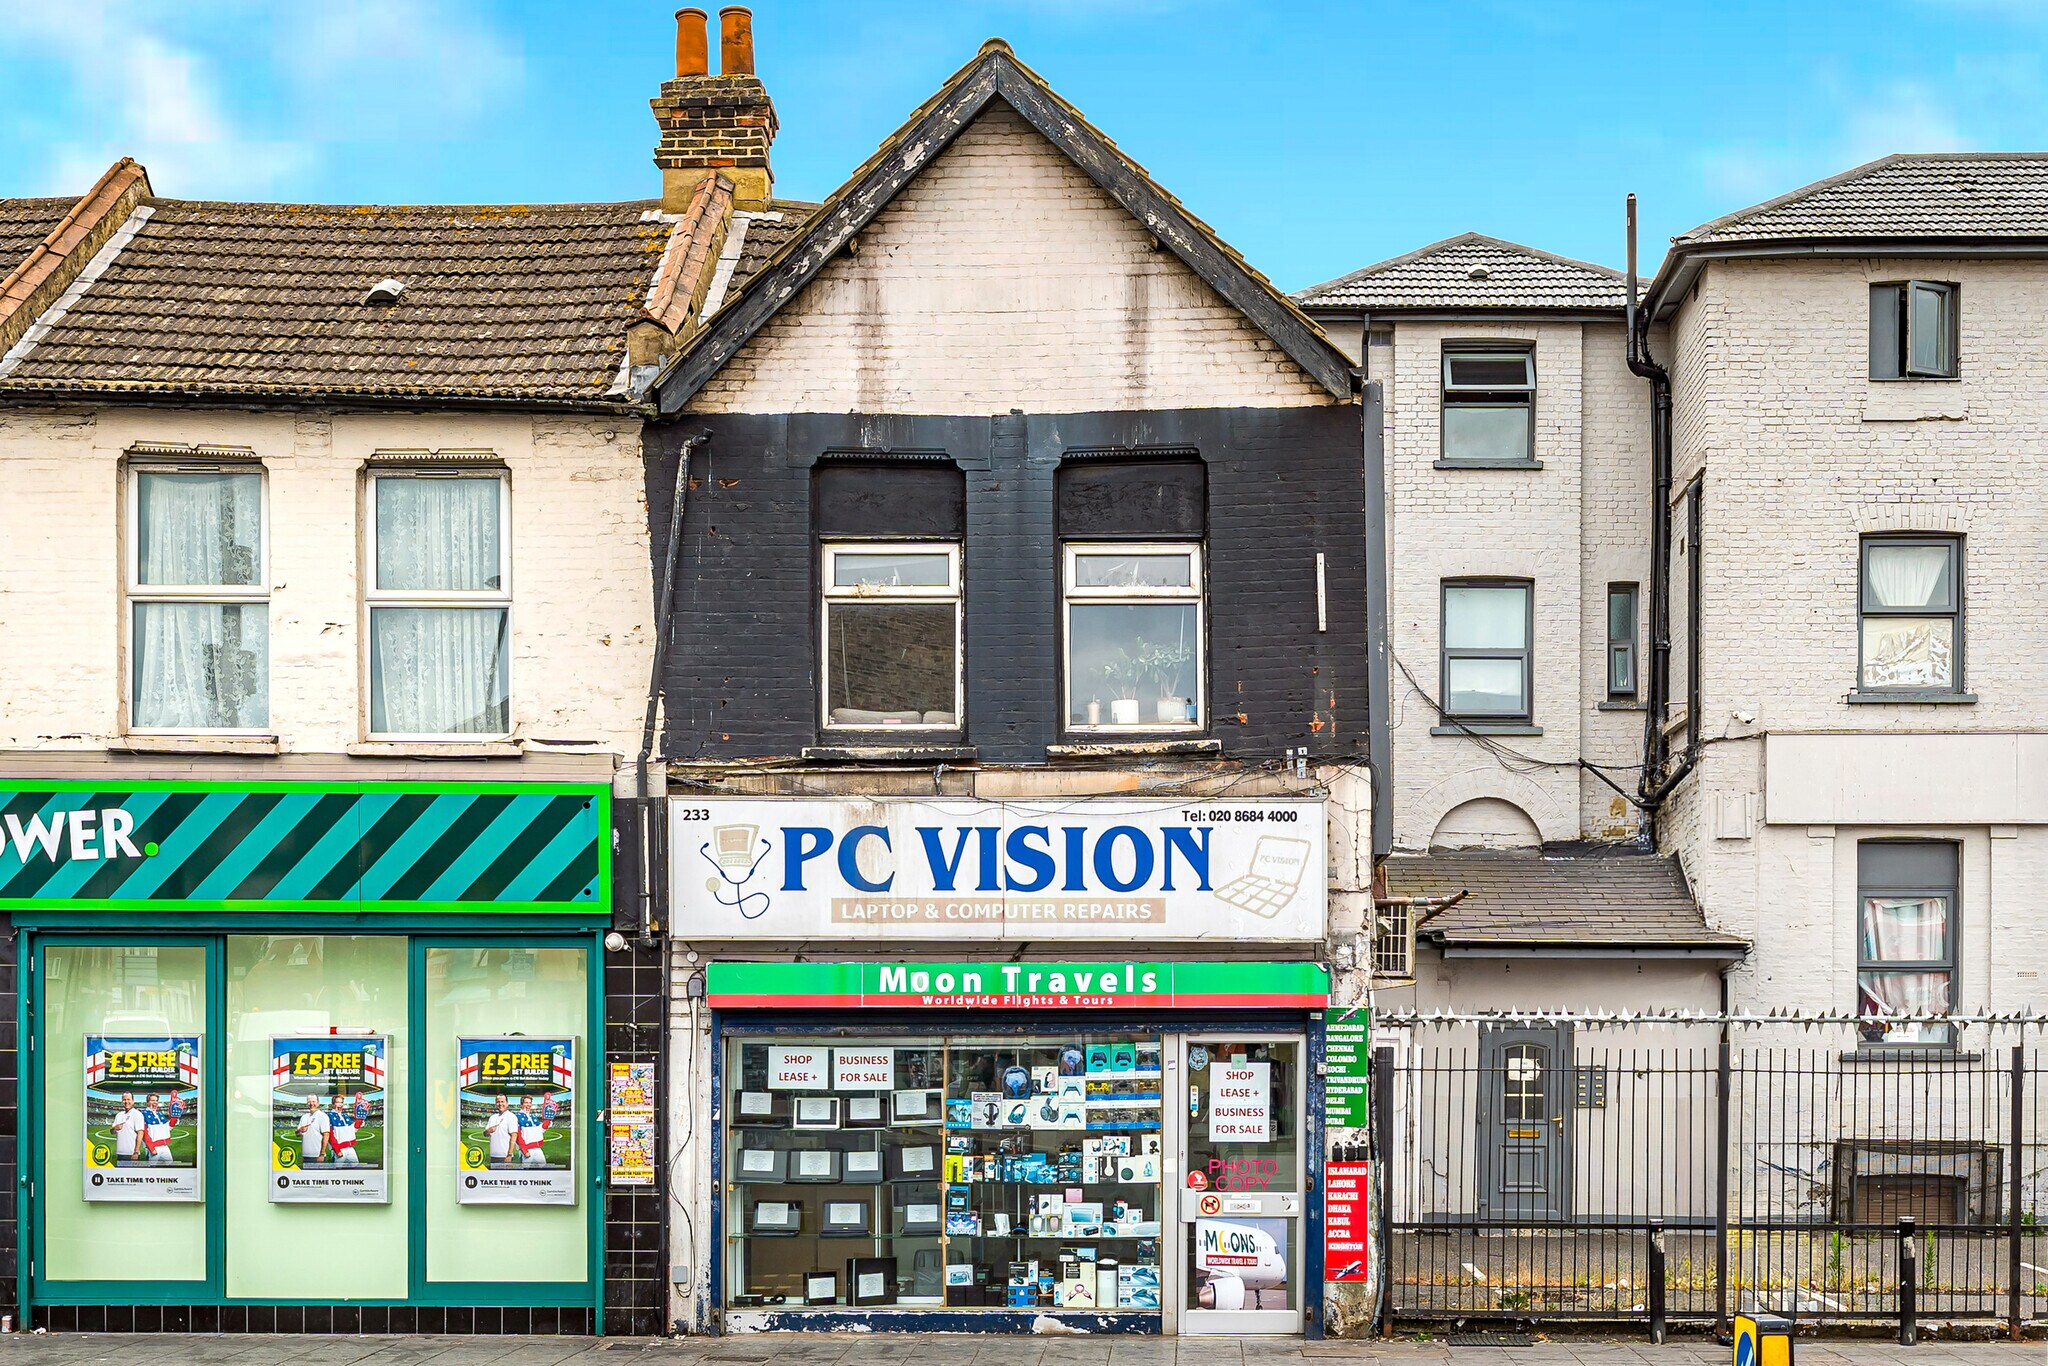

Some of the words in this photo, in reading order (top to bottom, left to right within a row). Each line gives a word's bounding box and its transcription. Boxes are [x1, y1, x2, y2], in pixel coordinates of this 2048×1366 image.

[683, 809, 710, 821] 233
[1182, 810, 1206, 822] Tel:
[1208, 810, 1231, 822] 020
[1234, 810, 1264, 822] 8684
[1267, 810, 1298, 822] 4000
[0, 808, 159, 864] WER.
[780, 825, 895, 893] PC
[915, 825, 1214, 893] VISION
[841, 903, 919, 919] LAPTOP
[925, 903, 940, 919] &
[945, 903, 1057, 919] COMPUTER
[1063, 903, 1152, 919] REPAIRS
[879, 966, 982, 993] Moon
[1001, 965, 1157, 993] Travels
[922, 995, 998, 1005] Worldwide
[1004, 995, 1054, 1007] Flights
[1059, 995, 1069, 1005] &
[1074, 995, 1114, 1005] Tours
[1326, 1034, 1364, 1042] BANGALORE
[1326, 1045, 1355, 1053] CHENNAI
[109, 1051, 137, 1073] £5
[138, 1051, 176, 1067] FREE
[784, 1055, 812, 1064] SHOP
[839, 1056, 888, 1065] BUSINESS
[1326, 1055, 1358, 1063] COLOMBO
[293, 1053, 322, 1075] £5
[323, 1053, 360, 1069] FREE
[482, 1053, 511, 1075] £5
[512, 1053, 549, 1069] FREE
[778, 1072, 808, 1081] LEASE
[840, 1073, 861, 1082] FOR
[863, 1073, 888, 1082] SALE
[1225, 1071, 1254, 1080] SHOP
[1220, 1088, 1251, 1097] LEASE
[1326, 1086, 1364, 1094] HYDERABAD
[1215, 1108, 1264, 1117] BUSINESS
[1215, 1125, 1236, 1134] FOR
[1239, 1125, 1263, 1134] SALE
[1208, 1158, 1278, 1176] PHOTO
[1328, 1167, 1367, 1176] ISLAMABAD
[1215, 1175, 1271, 1193] COPY
[1328, 1179, 1357, 1188] LAHORE
[1328, 1192, 1359, 1201] KARACHI
[1328, 1204, 1352, 1213] DHAKA
[1328, 1217, 1351, 1226] KABUL
[1328, 1229, 1351, 1238] ACCRA
